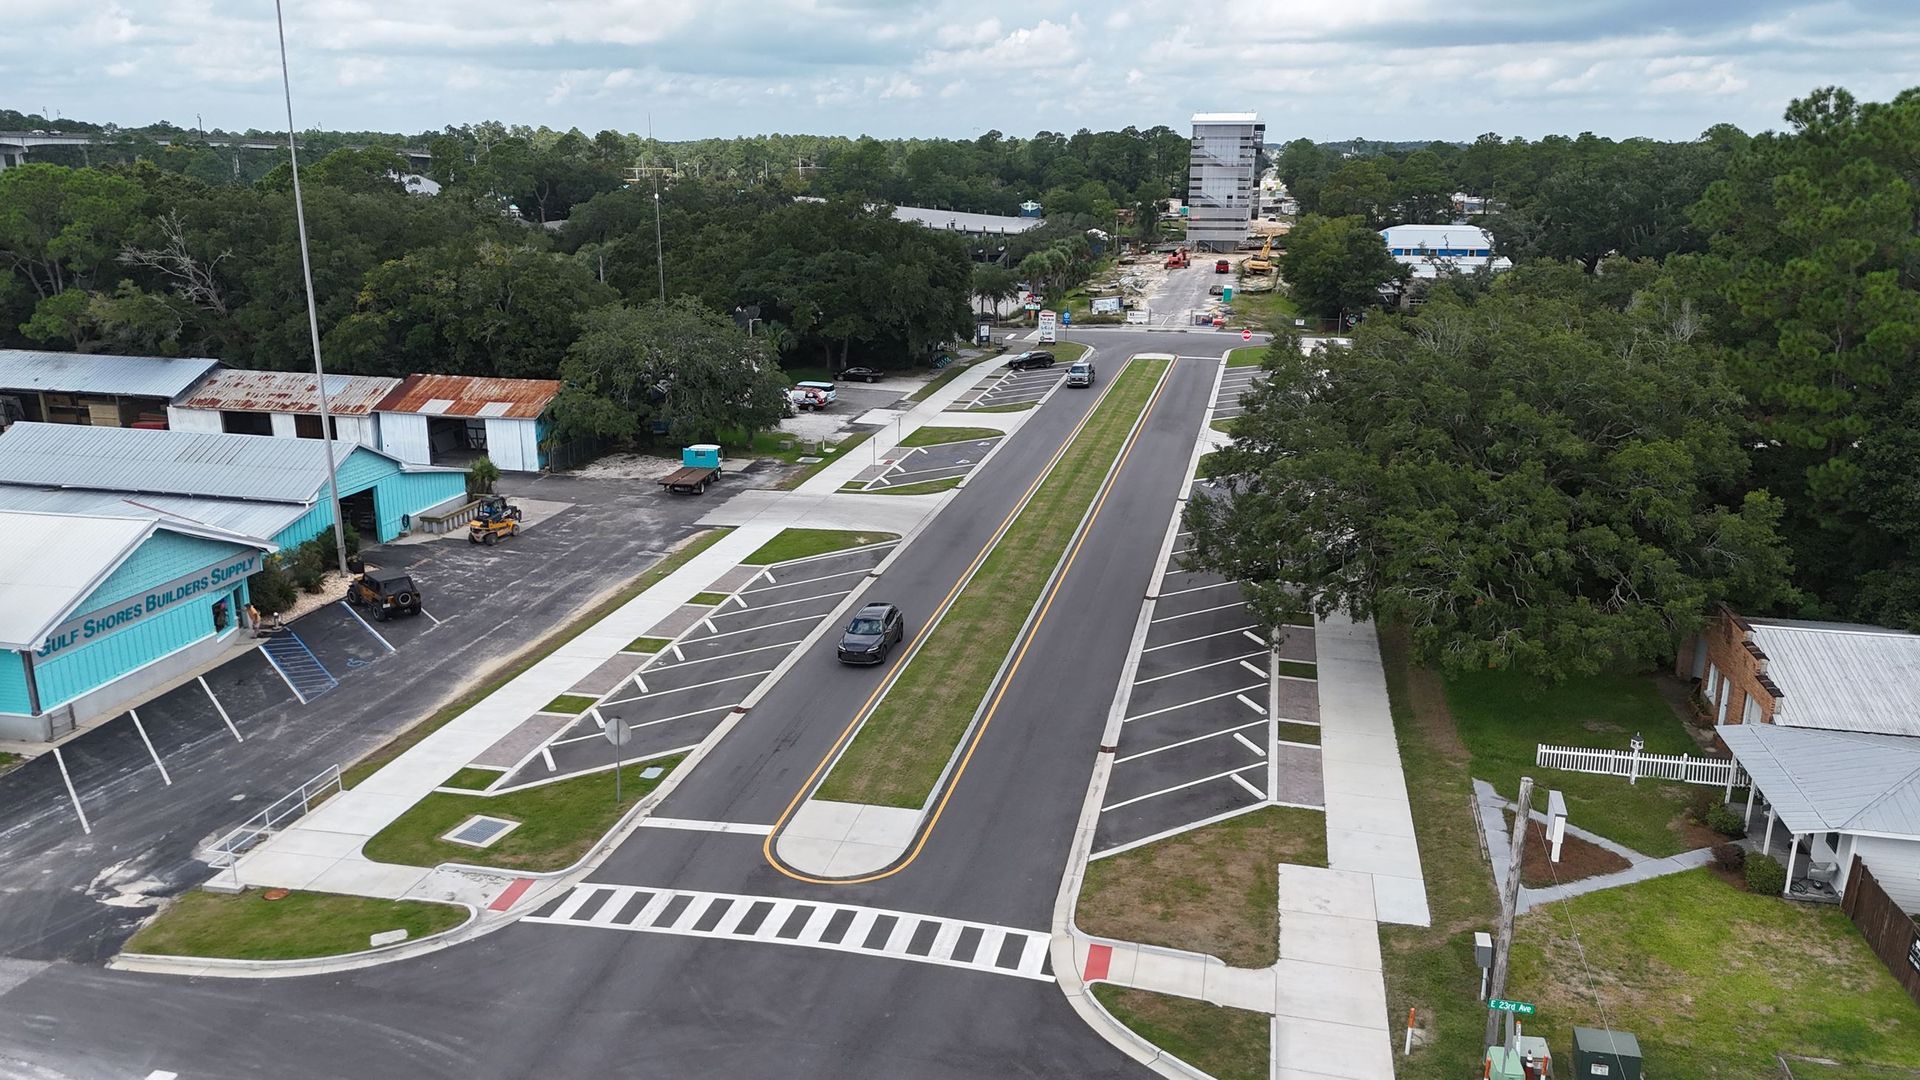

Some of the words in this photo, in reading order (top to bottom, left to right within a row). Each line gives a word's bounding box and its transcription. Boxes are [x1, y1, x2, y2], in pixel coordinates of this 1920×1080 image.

[83, 604, 142, 639] SHORES
[145, 577, 209, 613] BUILDERS
[210, 557, 255, 585] SUPPLY
[1490, 1000, 1497, 1008] E
[1498, 1001, 1516, 1011] 23rd
[1518, 1004, 1532, 1013] Ave
